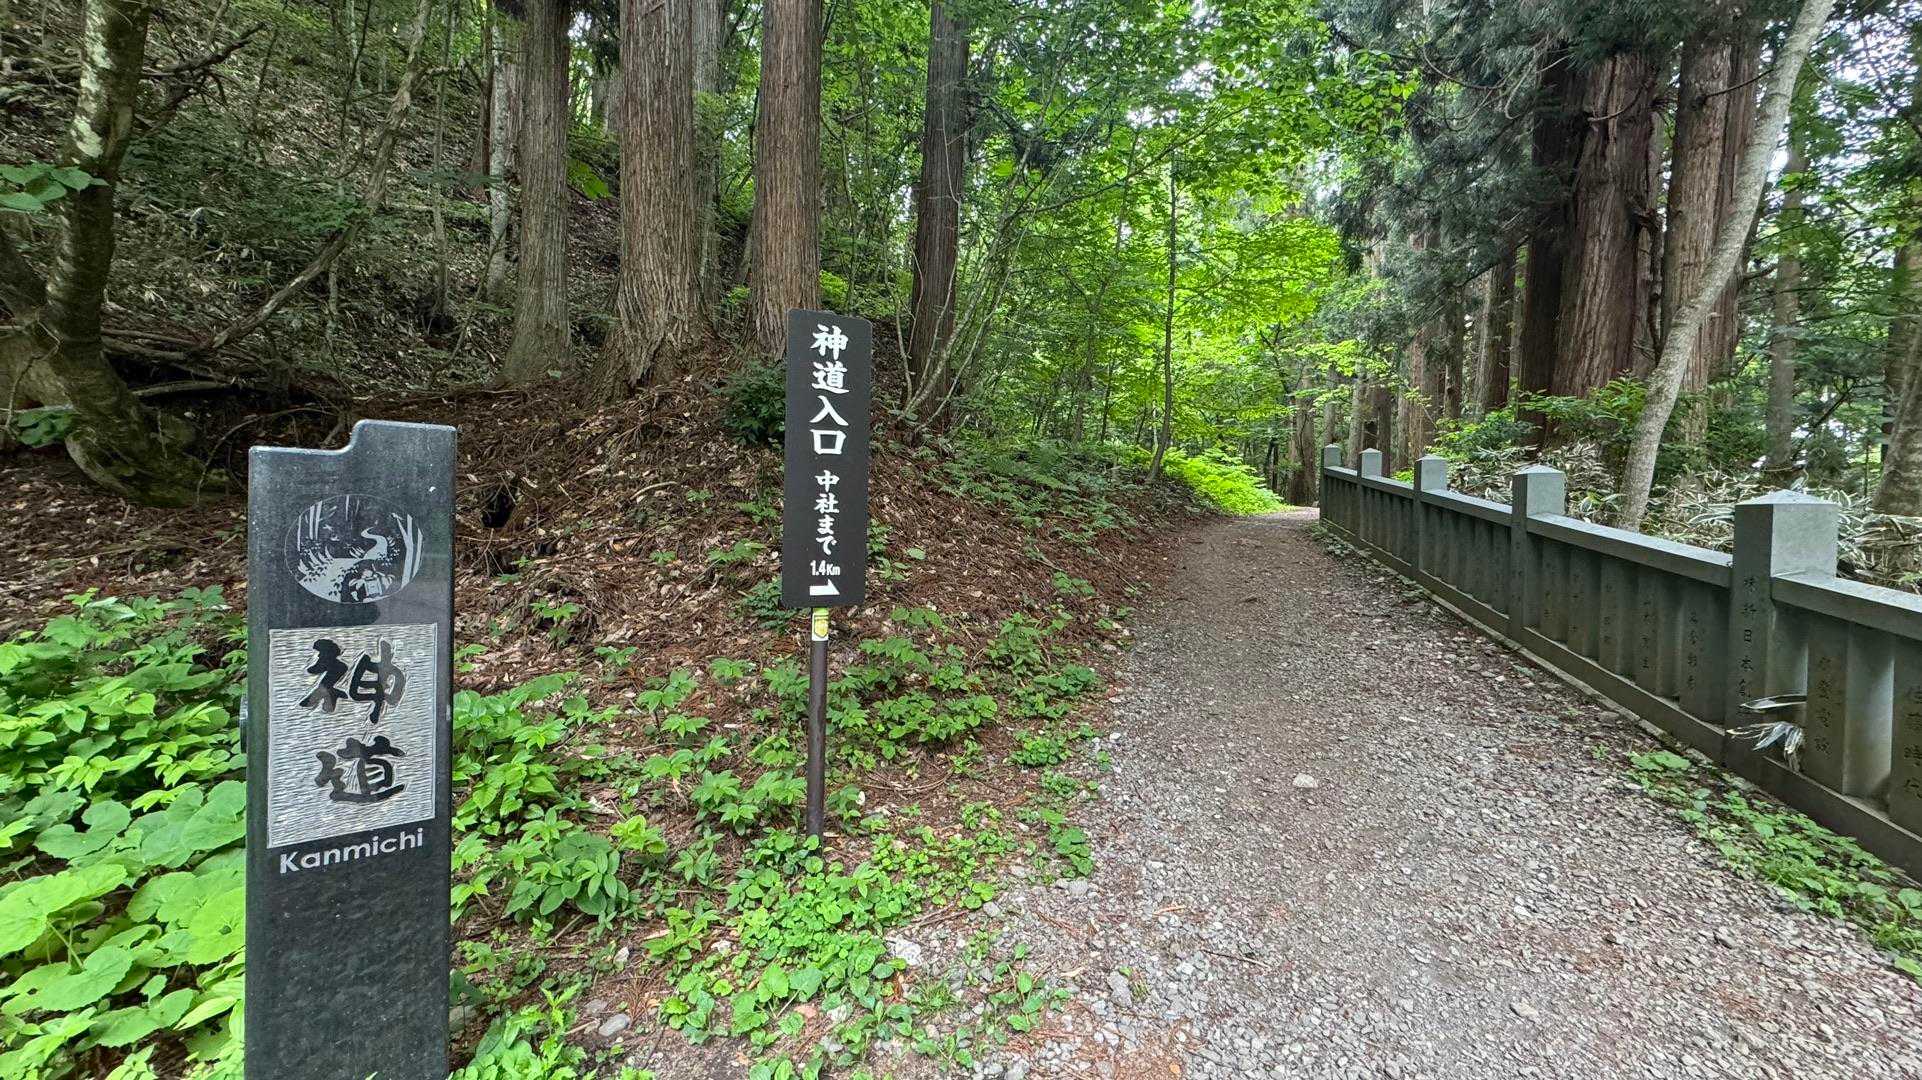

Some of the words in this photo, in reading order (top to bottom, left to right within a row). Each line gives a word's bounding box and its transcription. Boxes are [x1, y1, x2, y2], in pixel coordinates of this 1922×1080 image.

[810, 323, 850, 456] 神道入口
[813, 469, 840, 555] 中社まで
[810, 559, 841, 576] 1.4Km
[299, 638, 406, 804] 神道
[279, 828, 423, 874] Kanmichi
